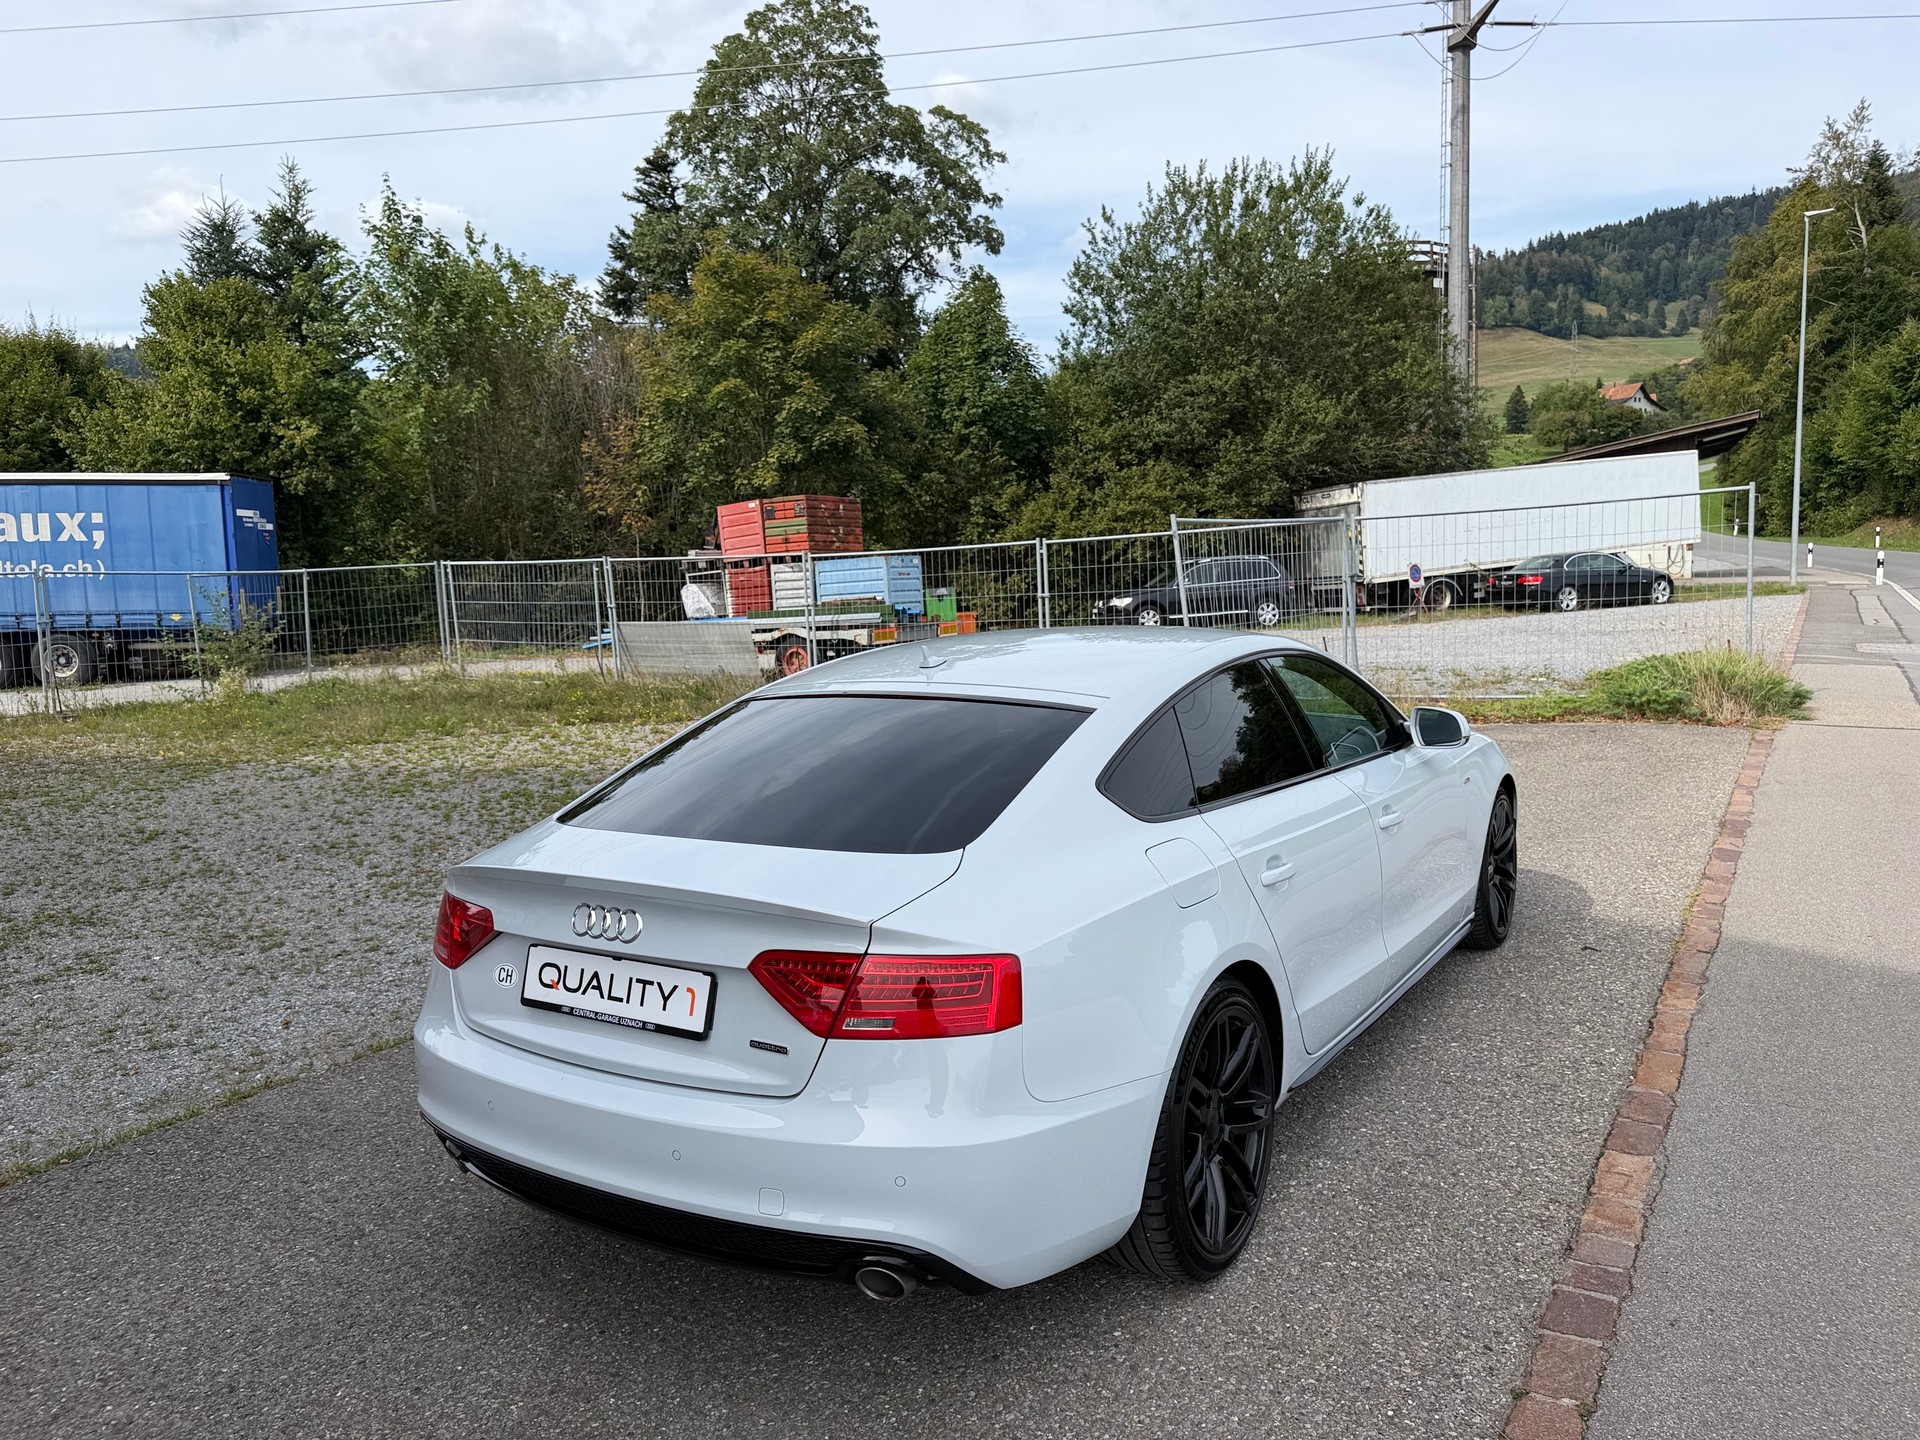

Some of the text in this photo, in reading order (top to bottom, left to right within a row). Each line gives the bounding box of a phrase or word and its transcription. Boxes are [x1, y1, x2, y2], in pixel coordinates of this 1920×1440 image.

[0, 512, 105, 549] aux;
[498, 967, 514, 980] CH
[538, 961, 696, 1017] QUALITY 1
[572, 1008, 643, 1028] CENTRAL-GARAGE UZNACH
[751, 1041, 787, 1053] quattro
